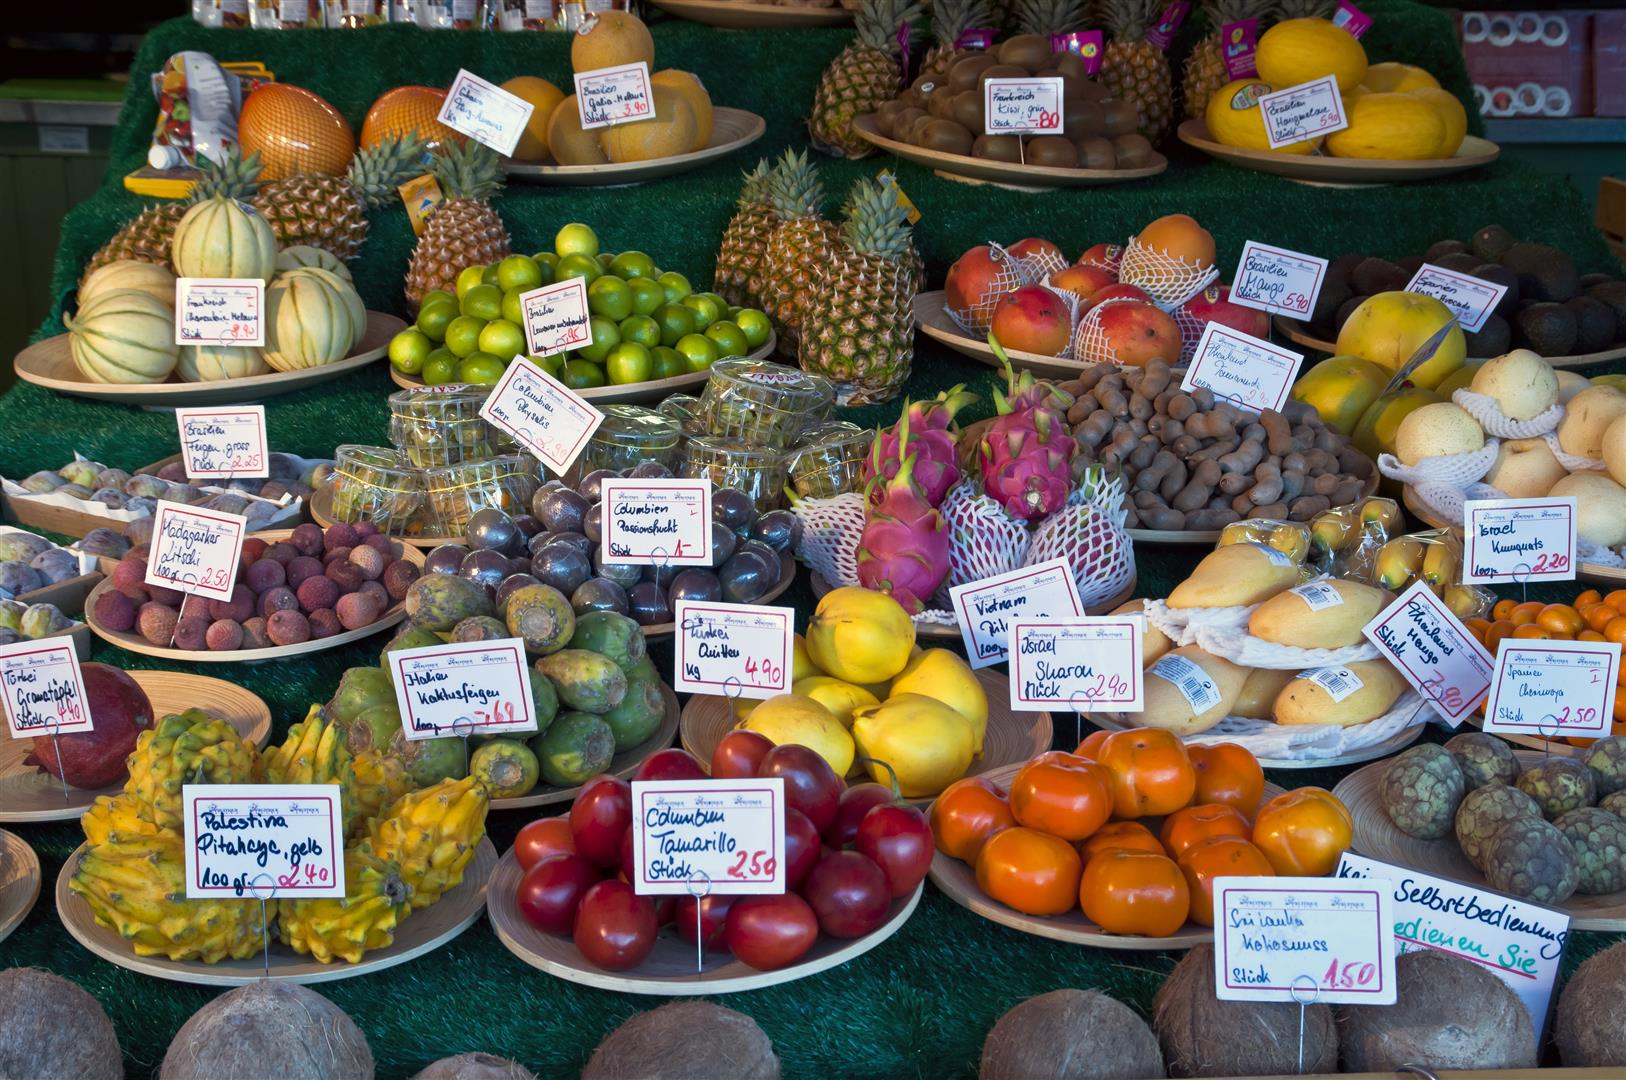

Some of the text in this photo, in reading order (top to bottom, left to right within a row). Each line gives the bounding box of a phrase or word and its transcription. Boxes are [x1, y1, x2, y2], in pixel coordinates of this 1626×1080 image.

[993, 91, 1035, 101] Frankreich
[1245, 255, 1288, 278] Brasilien
[1245, 271, 1285, 300] Mango
[1416, 277, 1458, 295] Spanien
[515, 398, 550, 430] Physalis
[184, 422, 225, 436] Brasilien
[613, 502, 669, 516] Columbien
[616, 518, 679, 536] Passionsfrucht
[1479, 520, 1516, 537] Israel
[1491, 537, 1543, 556] Kumquats
[975, 595, 1027, 617] Vietnam
[1408, 600, 1455, 657] Thailand
[698, 642, 740, 659] Quitten
[1021, 635, 1057, 655] Israel
[1407, 628, 1439, 665] Mango
[4, 669, 37, 686] Türkei
[405, 669, 449, 686] Italien
[1035, 660, 1095, 681] Sharon
[1507, 663, 1543, 680] Spanien
[416, 682, 500, 705] Kaktusfeigen
[1499, 706, 1524, 722] Stück
[201, 811, 288, 831] Palestina
[651, 830, 736, 855] Tamarillo
[649, 856, 692, 880] Stück
[1229, 908, 1254, 929] Sri
[1394, 878, 1569, 960] Selbstbedienung
[1394, 917, 1538, 975] edienen Sie
[1233, 964, 1271, 984] Stück
